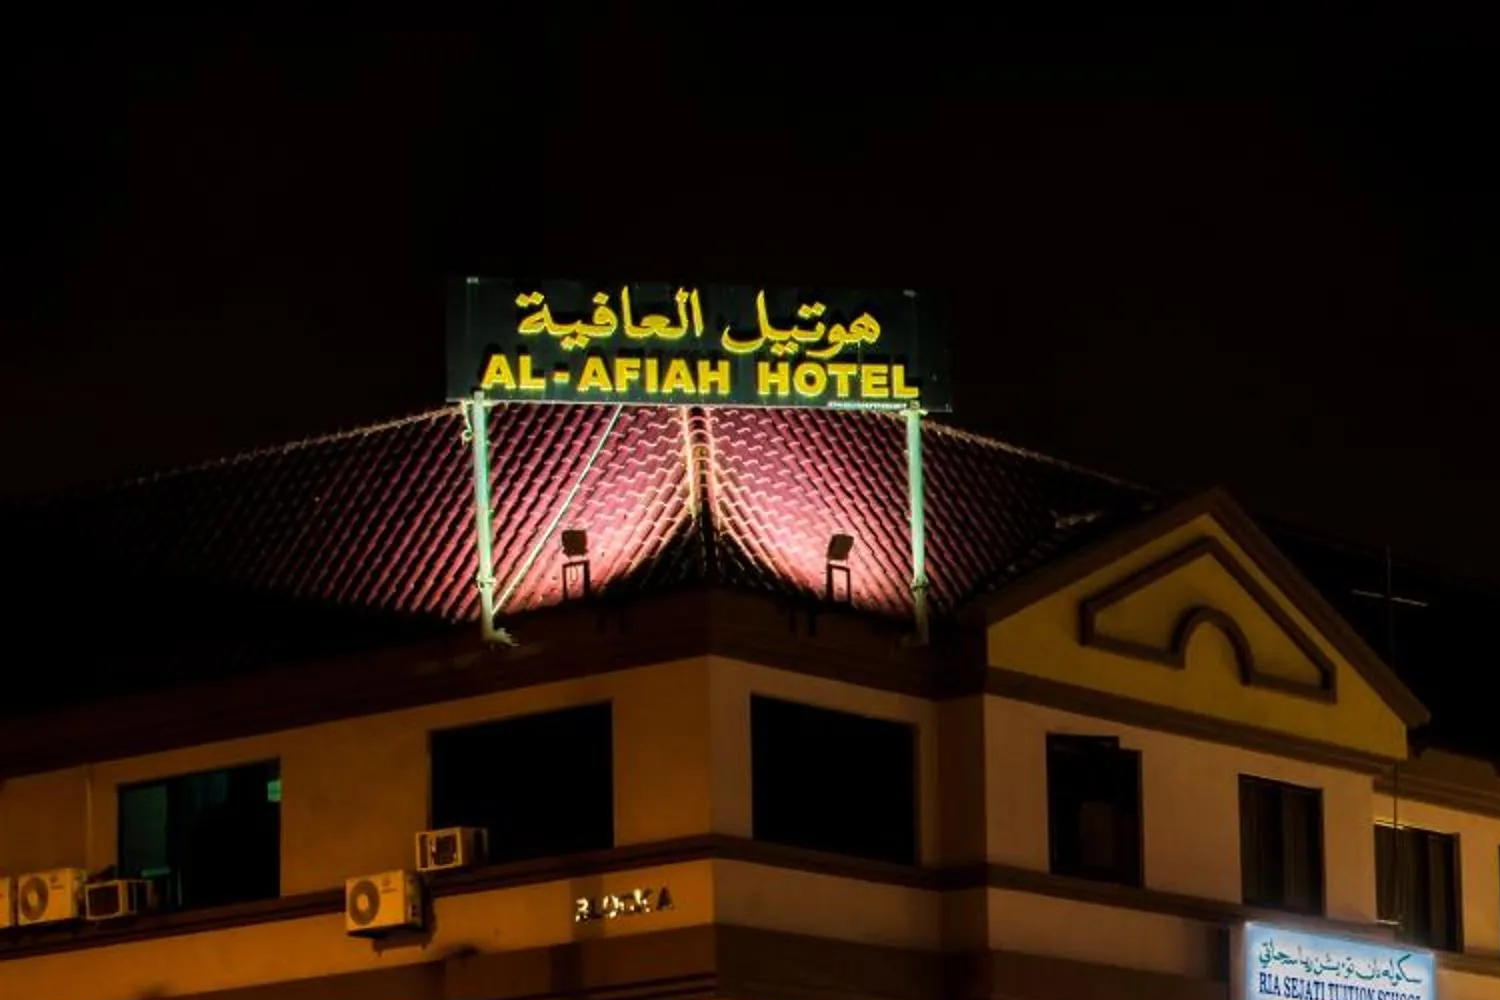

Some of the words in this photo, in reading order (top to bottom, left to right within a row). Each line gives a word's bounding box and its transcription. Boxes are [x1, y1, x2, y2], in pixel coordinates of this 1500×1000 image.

[514, 286, 705, 351] العافية
[720, 289, 882, 358] هوتيل
[757, 361, 920, 398] HOTEL
[1259, 972, 1281, 996] RIA
